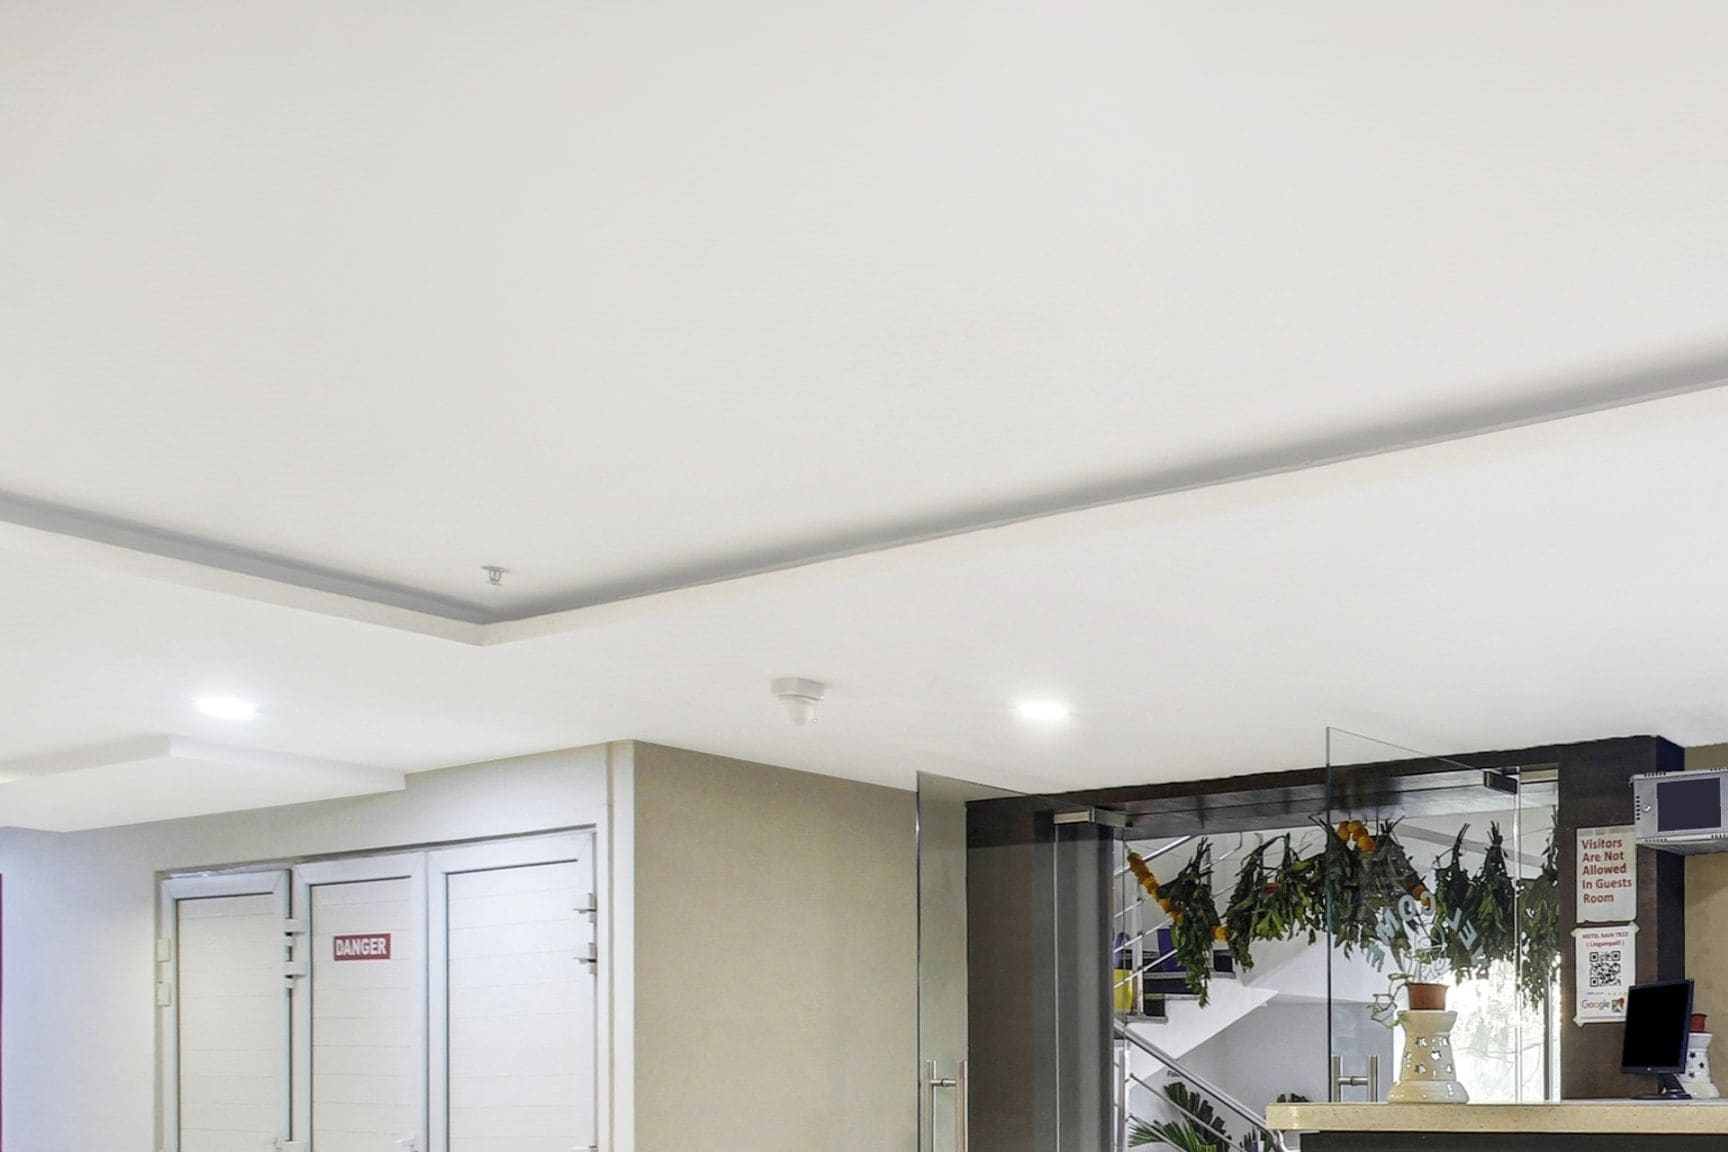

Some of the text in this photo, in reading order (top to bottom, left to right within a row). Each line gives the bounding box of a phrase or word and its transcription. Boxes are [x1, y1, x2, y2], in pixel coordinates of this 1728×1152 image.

[1582, 839, 1622, 849] Visitors
[1583, 851, 1624, 862] Are Not
[1583, 863, 1627, 875] Allowed
[1582, 879, 1632, 889] In Guests
[1583, 893, 1614, 903] Room
[336, 938, 387, 956] DANGER
[1582, 999, 1610, 1010] Google
